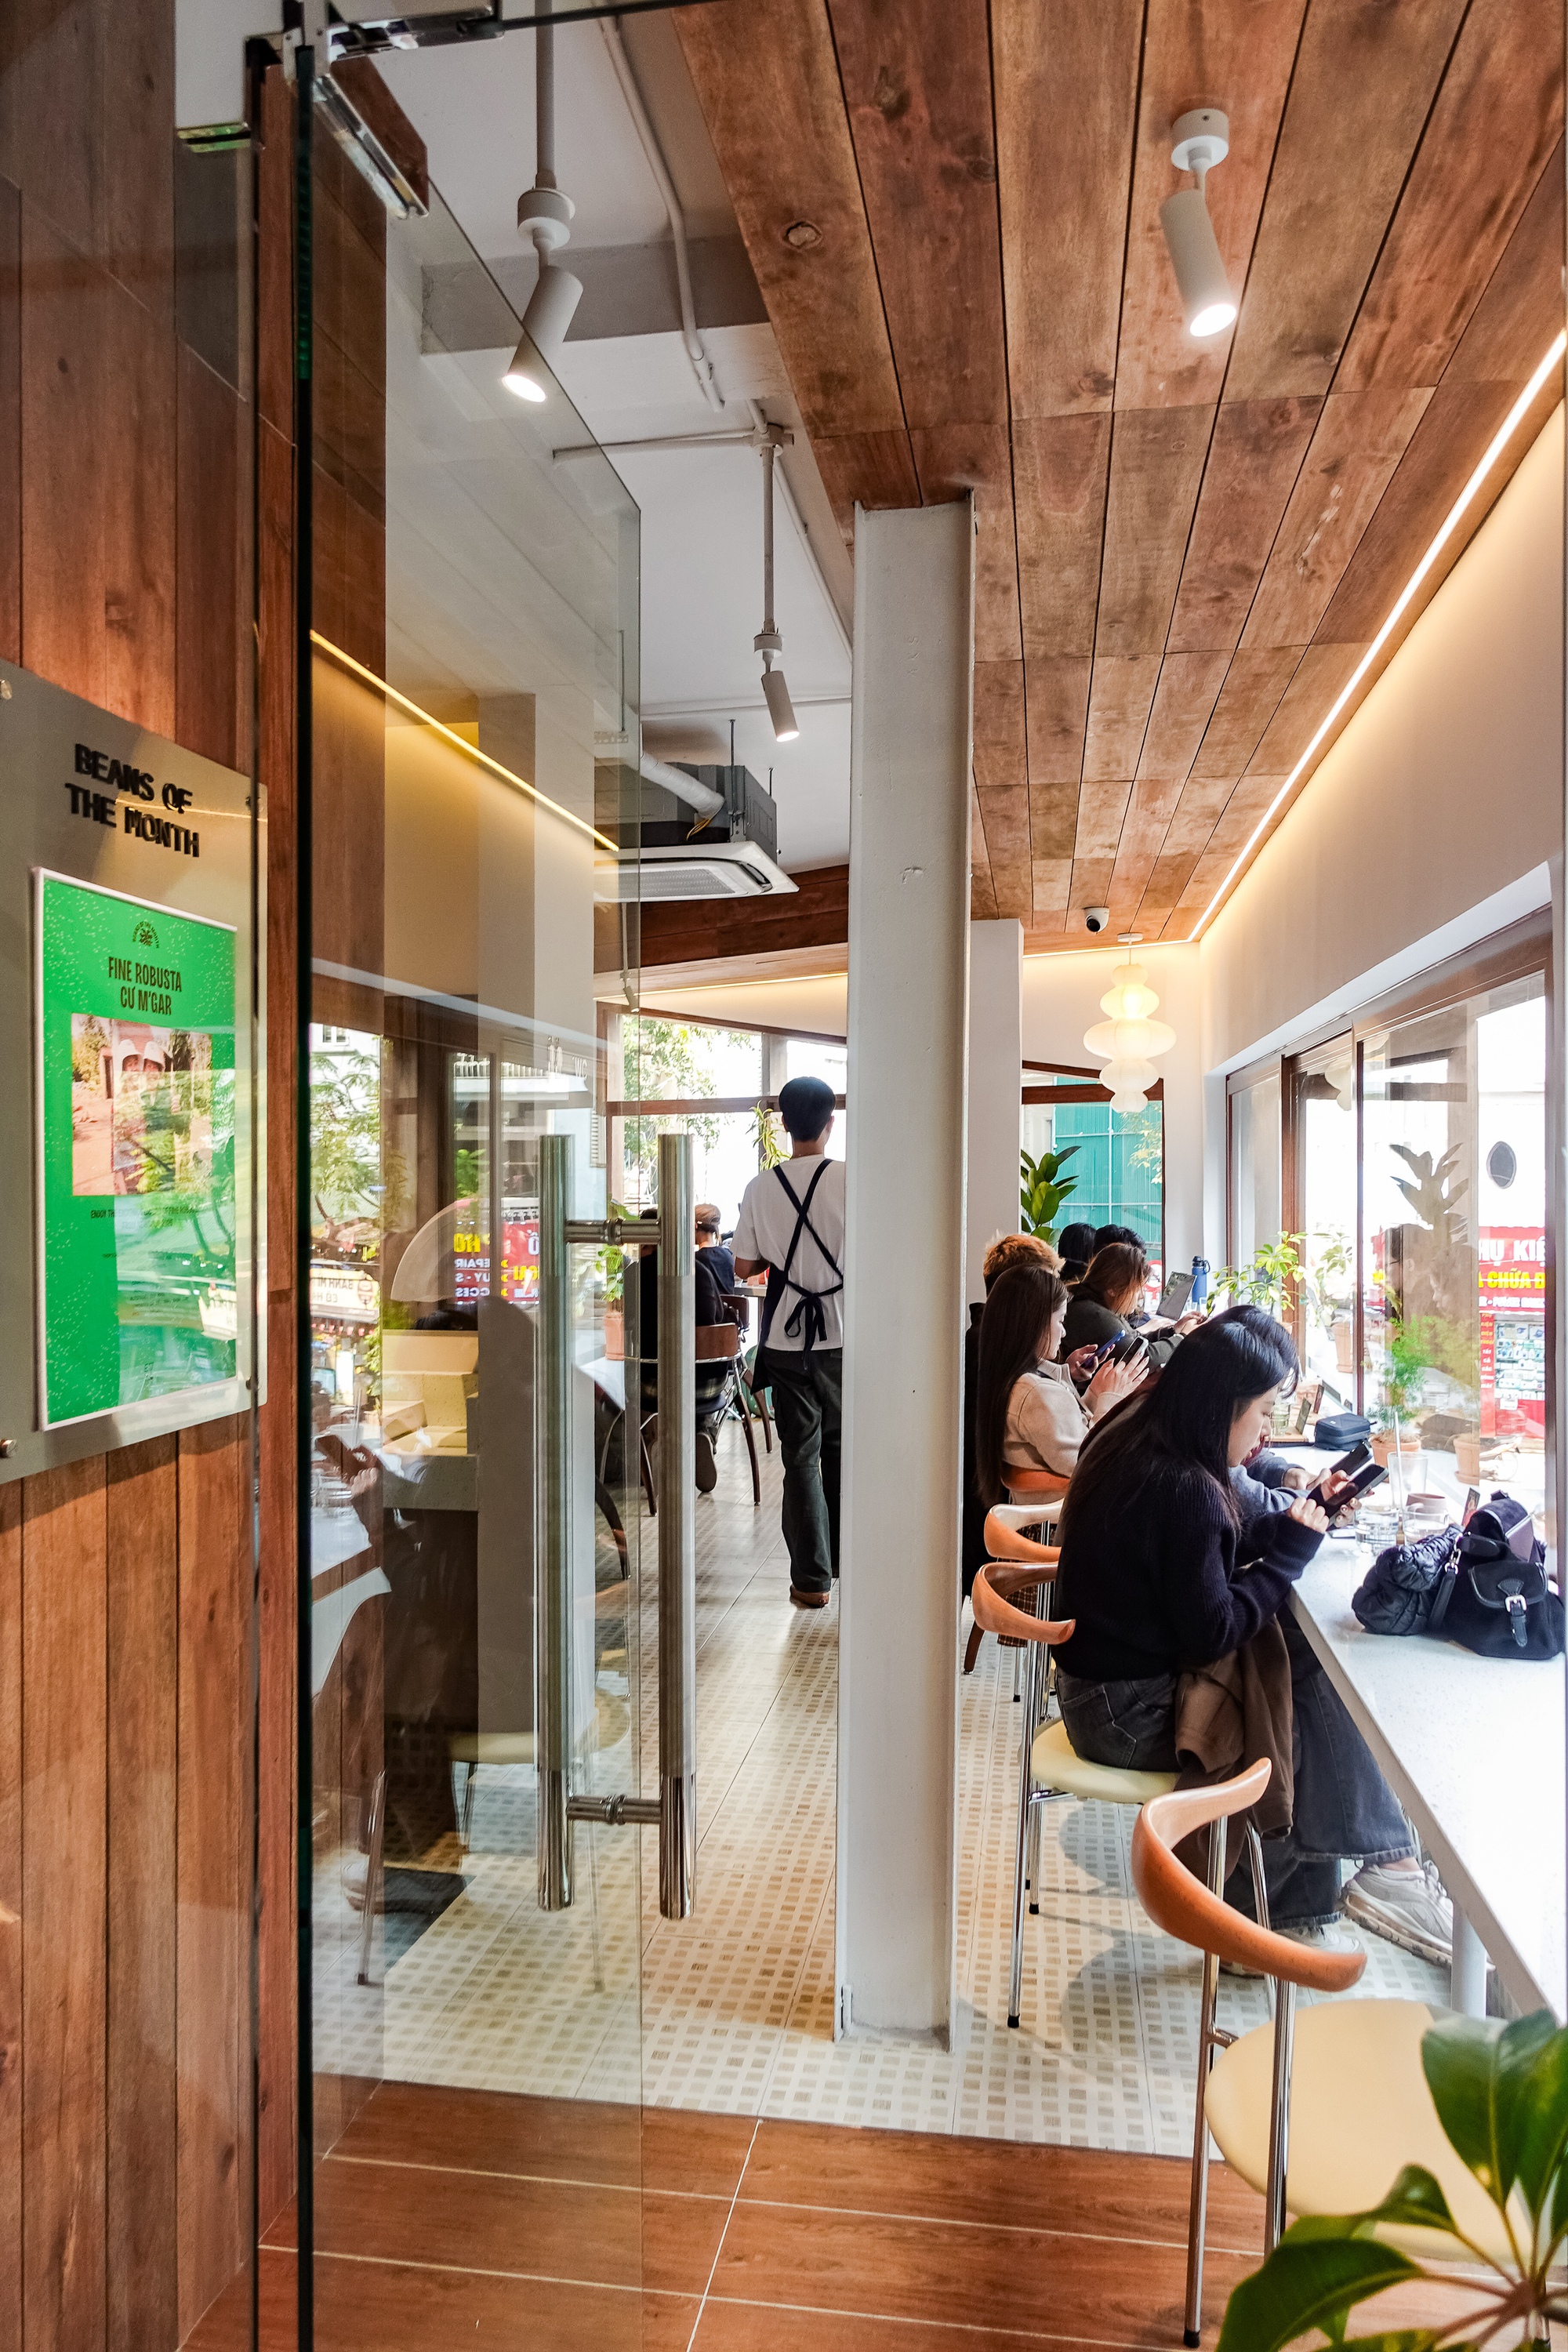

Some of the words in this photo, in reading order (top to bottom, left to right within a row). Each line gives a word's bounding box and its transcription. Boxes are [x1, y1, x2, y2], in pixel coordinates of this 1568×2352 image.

[74, 743, 154, 800] BEANS
[162, 783, 193, 814] OF
[64, 782, 117, 828] THE
[125, 806, 199, 857] MONTH
[109, 956, 132, 982] FINE
[135, 962, 182, 992] ROBUSTA
[572, 1056, 587, 1080] WC
[1487, 1267, 1531, 1289] CHỮA
